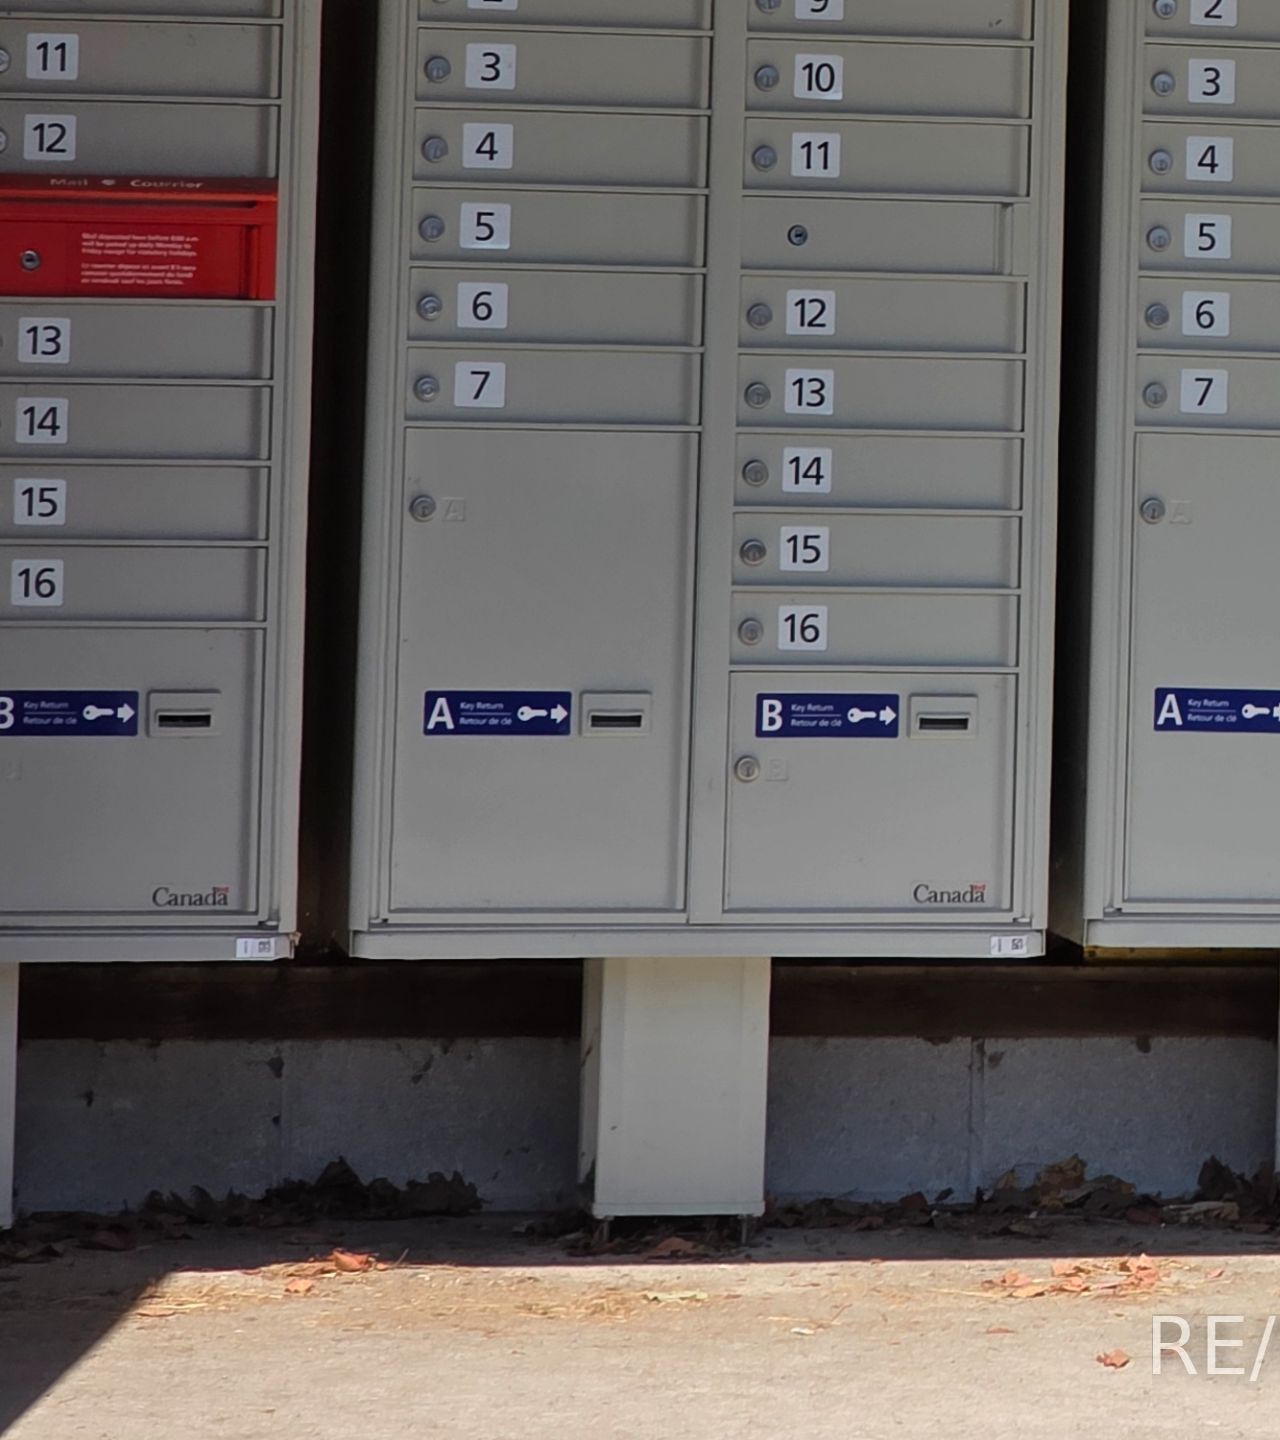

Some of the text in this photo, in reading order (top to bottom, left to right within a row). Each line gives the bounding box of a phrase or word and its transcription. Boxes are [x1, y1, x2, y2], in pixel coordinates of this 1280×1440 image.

[36, 41, 67, 72] 11
[480, 51, 501, 82] 3
[801, 62, 835, 93] 10
[1202, 67, 1221, 97] 3
[32, 122, 67, 154] 12
[475, 131, 499, 161] 4
[800, 140, 829, 171] 11
[1197, 144, 1219, 174] 4
[475, 211, 495, 242] 5
[1198, 222, 1216, 252] 5
[472, 290, 493, 321] 6
[794, 298, 827, 328] 12
[1195, 299, 1215, 330] 6
[26, 325, 62, 356] 13
[470, 370, 491, 400] 7
[791, 377, 826, 408] 13
[1194, 377, 1214, 407] 7
[23, 405, 61, 437] 14
[788, 455, 825, 486] 14
[21, 486, 58, 518] 15
[786, 534, 821, 564] 15
[17, 567, 56, 599] 16
[784, 613, 820, 643] 16
[427, 697, 455, 730] A
[761, 699, 783, 731] B
[1156, 693, 1184, 726] A
[152, 886, 229, 907] Canada
[913, 883, 985, 904] Canada
